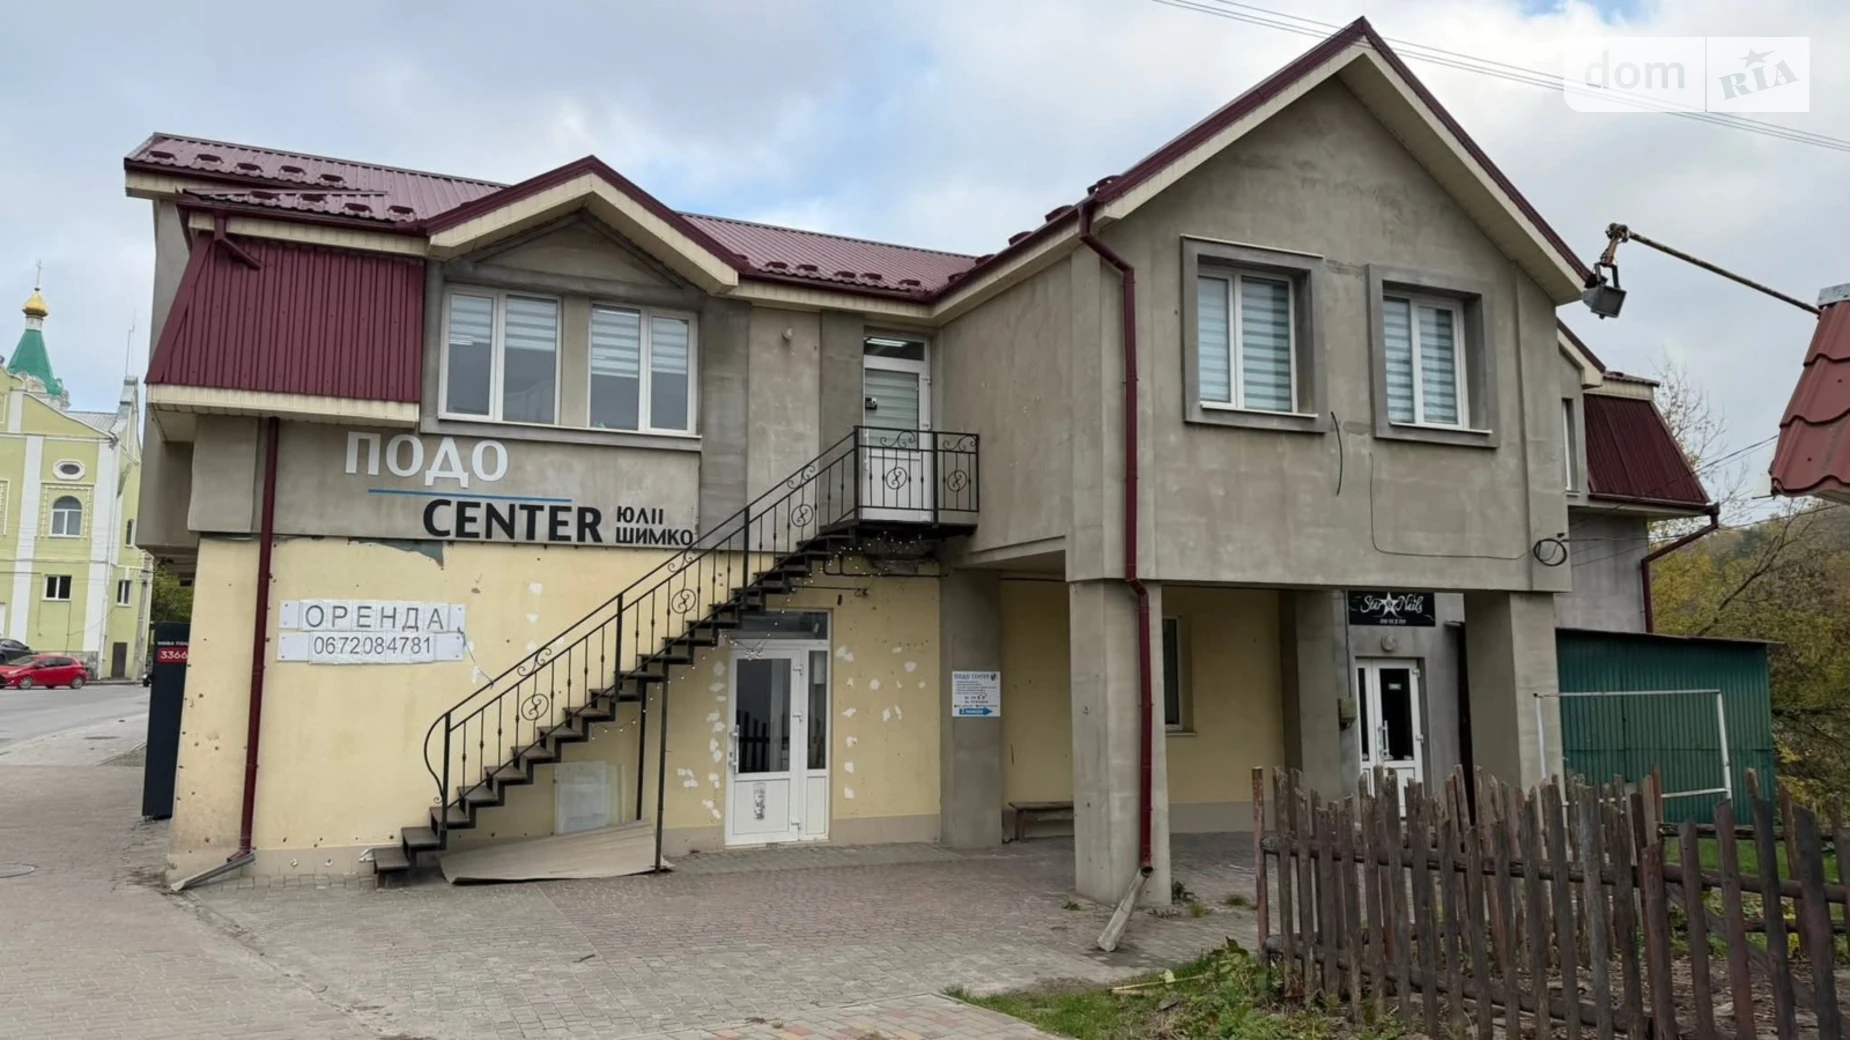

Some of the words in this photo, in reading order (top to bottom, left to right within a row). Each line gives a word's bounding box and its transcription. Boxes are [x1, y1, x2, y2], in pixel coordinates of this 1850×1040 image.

[345, 431, 509, 489] ПОДО
[423, 499, 603, 543] CENTER
[615, 527, 694, 546] ШИМКО
[1395, 593, 1424, 614] Nails
[305, 604, 444, 632] ОРЕНДА
[160, 650, 188, 660] 3366
[313, 636, 431, 655] 0672084781
